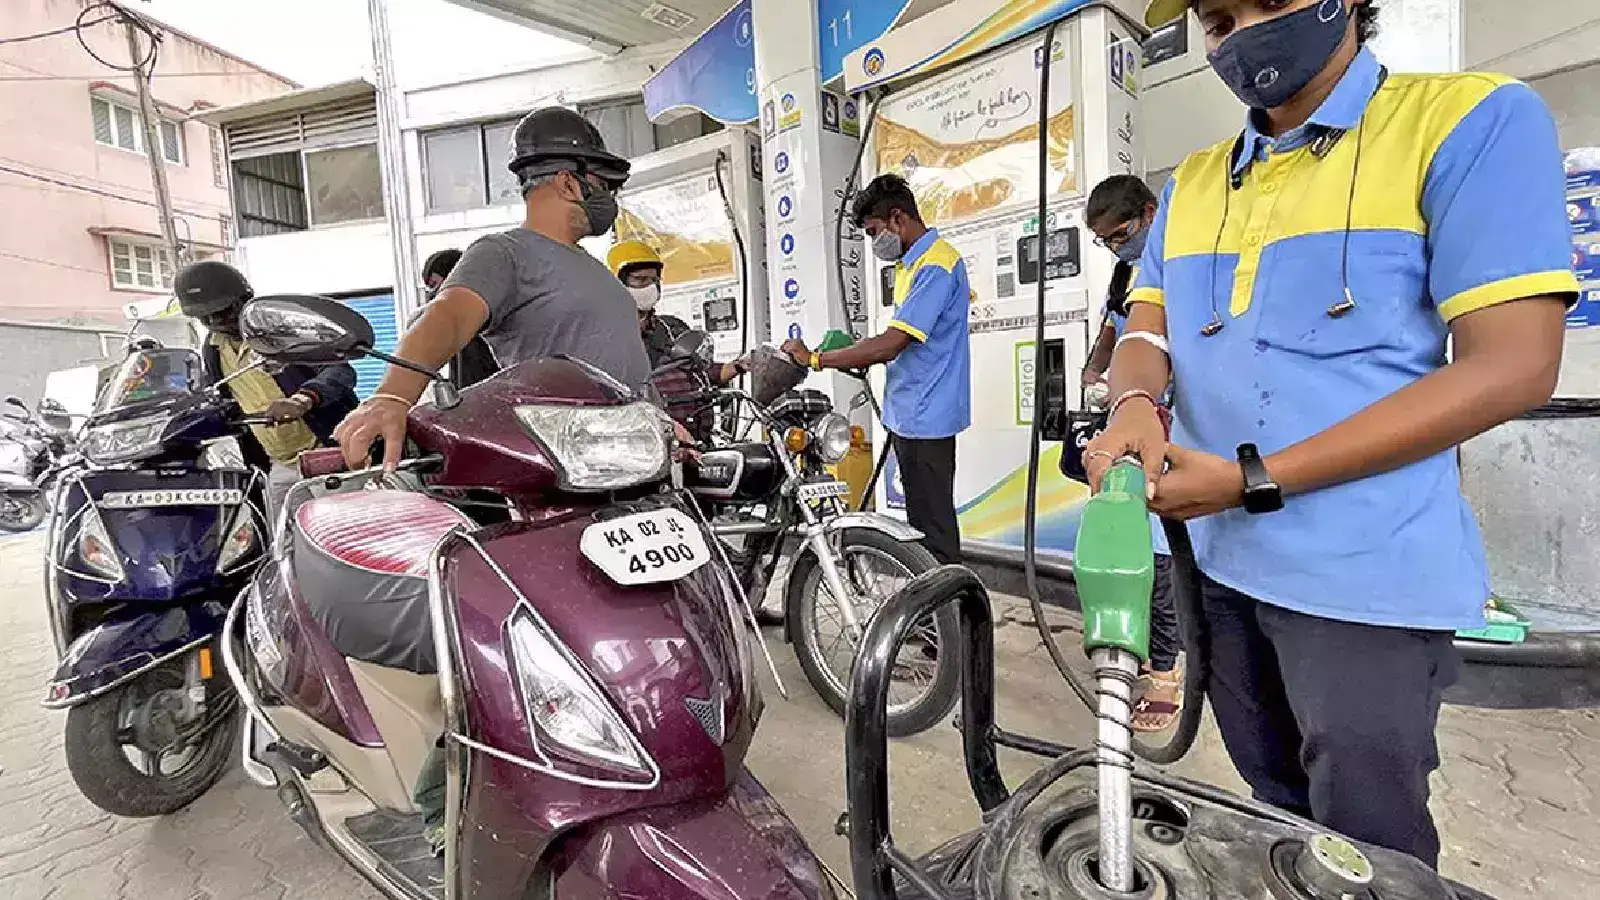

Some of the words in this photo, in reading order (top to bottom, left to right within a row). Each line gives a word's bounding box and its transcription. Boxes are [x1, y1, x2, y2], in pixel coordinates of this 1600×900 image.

[828, 9, 852, 47] 11
[746, 67, 756, 95] 9
[1020, 358, 1035, 408] Petrol
[603, 528, 633, 547] KA
[638, 520, 660, 536] 02
[629, 543, 694, 573] 4900
